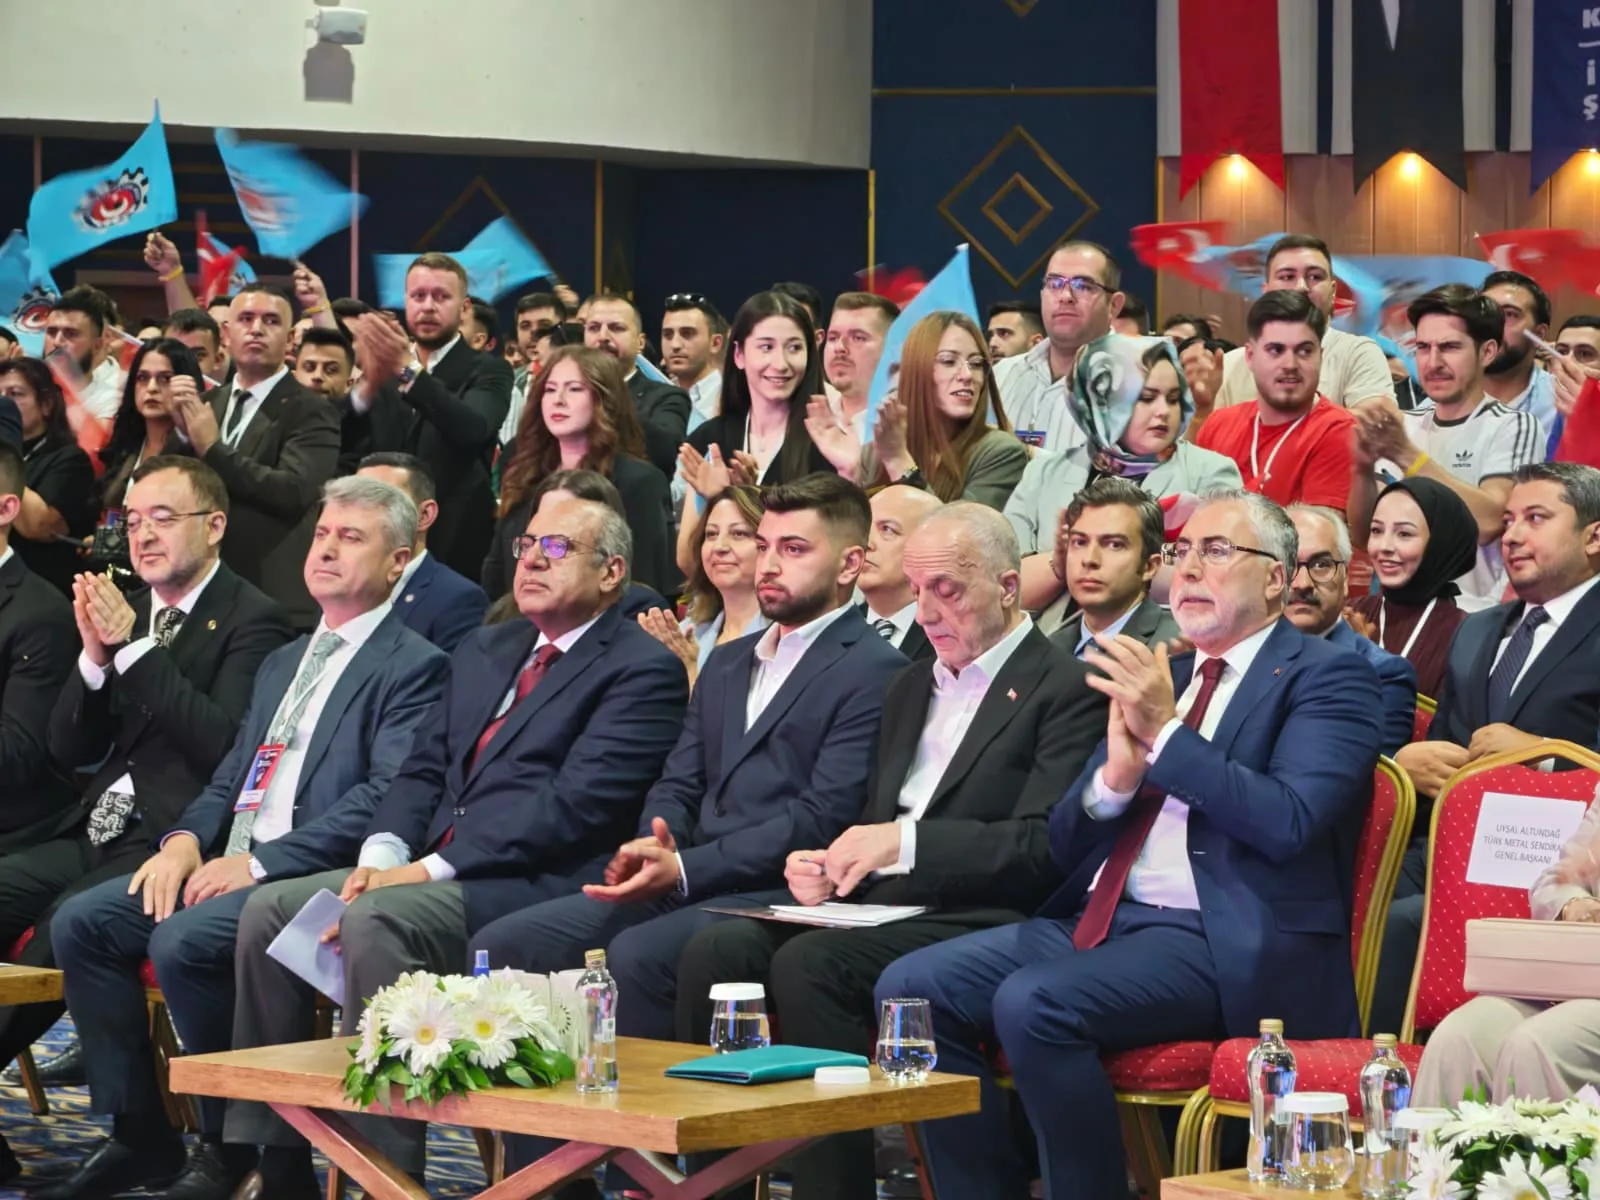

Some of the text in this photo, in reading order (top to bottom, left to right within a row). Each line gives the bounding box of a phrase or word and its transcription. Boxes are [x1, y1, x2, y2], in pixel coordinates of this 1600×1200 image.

[1496, 824, 1518, 834] UYSAL
[1483, 835, 1502, 845] TÜRK
[1505, 838, 1528, 849] METAL
[1494, 850, 1551, 865] GENEL BAŞKANI
